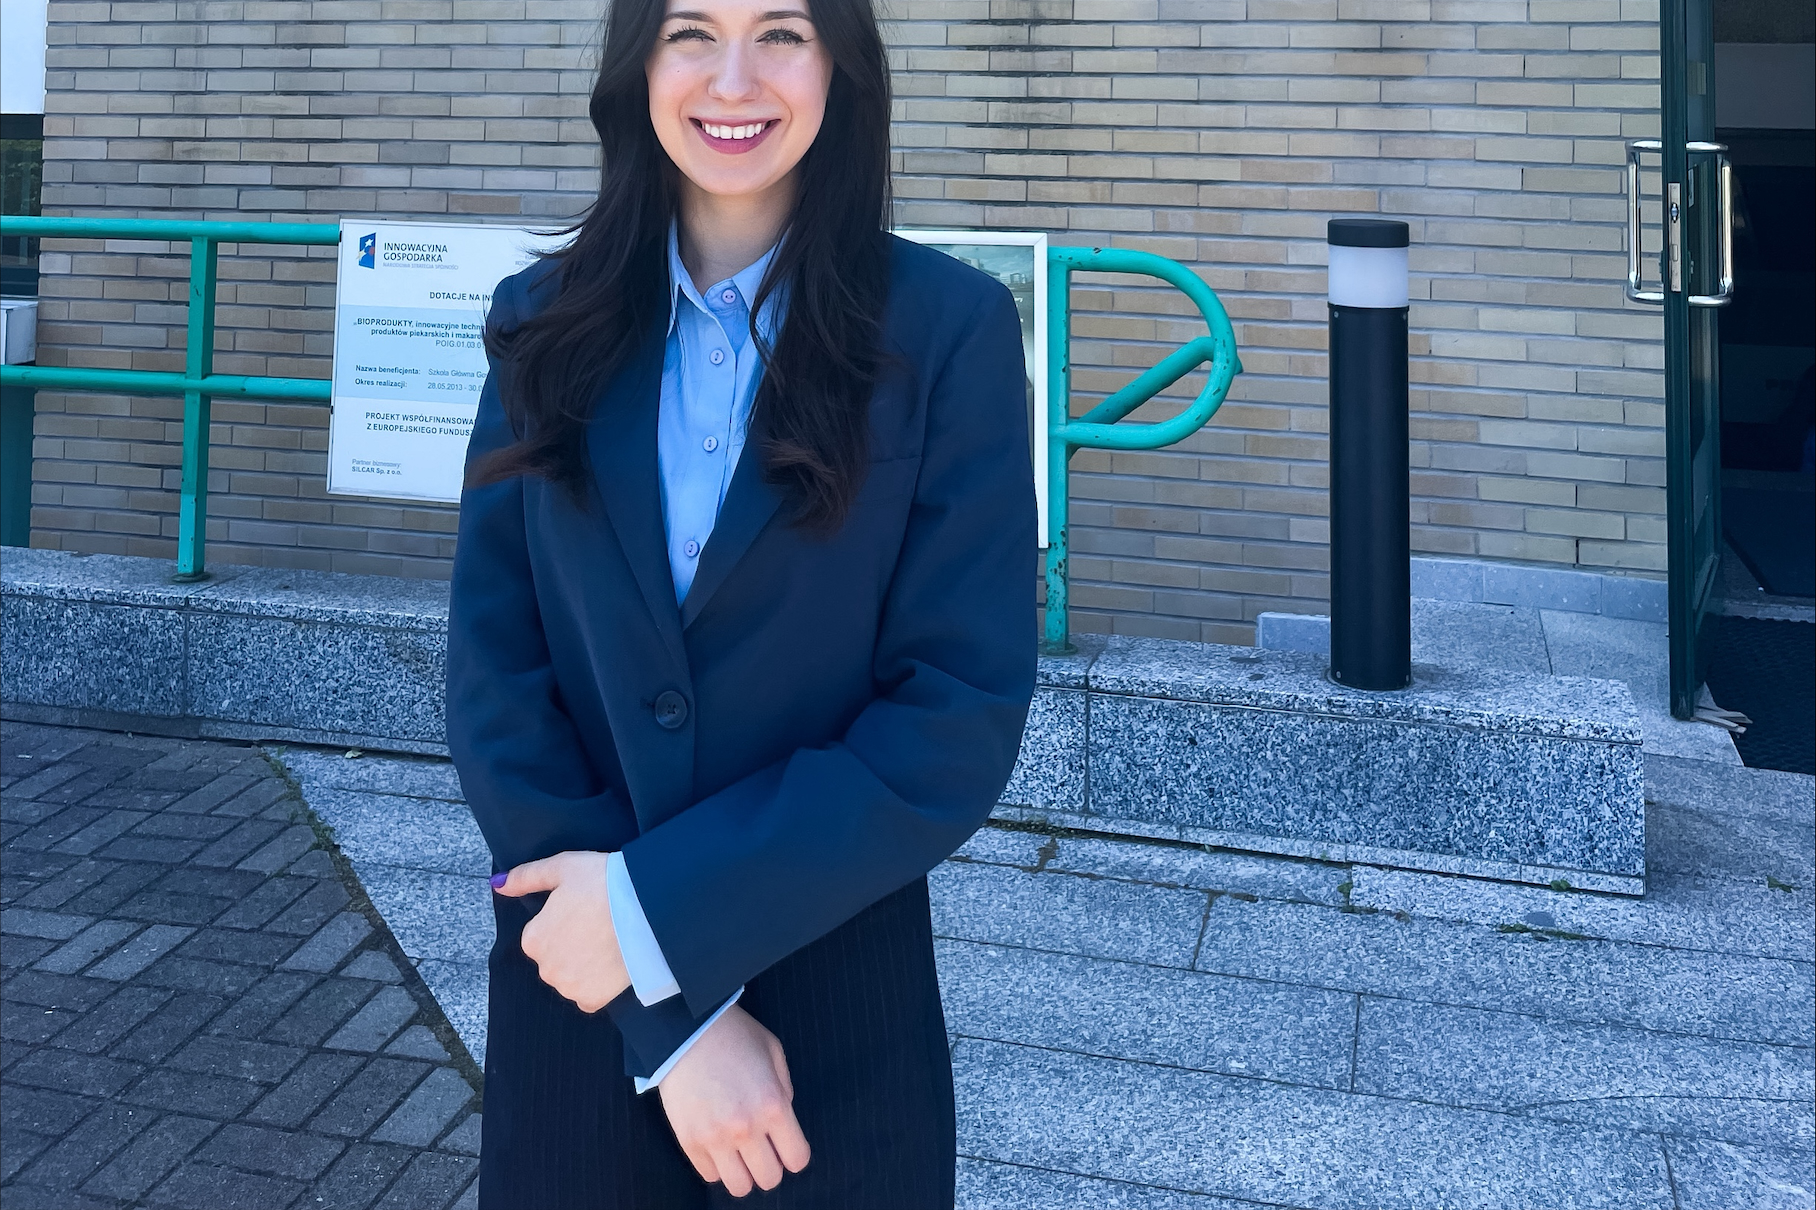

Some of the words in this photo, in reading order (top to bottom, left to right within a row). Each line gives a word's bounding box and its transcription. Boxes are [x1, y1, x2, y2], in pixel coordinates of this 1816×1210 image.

[384, 242, 448, 253] INNOWACYJNA
[383, 252, 443, 262] GOSPODARKA
[429, 292, 467, 301] DOTACJE
[469, 293, 480, 301] NA
[415, 321, 459, 330] innowacyjne
[371, 328, 408, 336] produktów
[410, 330, 450, 338] piekarskich
[379, 366, 421, 375] beneficjenta:
[451, 369, 475, 378] Główna
[376, 380, 408, 389] realizacji:
[427, 382, 463, 391] 28.05.2013
[365, 412, 400, 421] PROJEKT
[373, 424, 437, 434] EUROPEJSKIEGO
